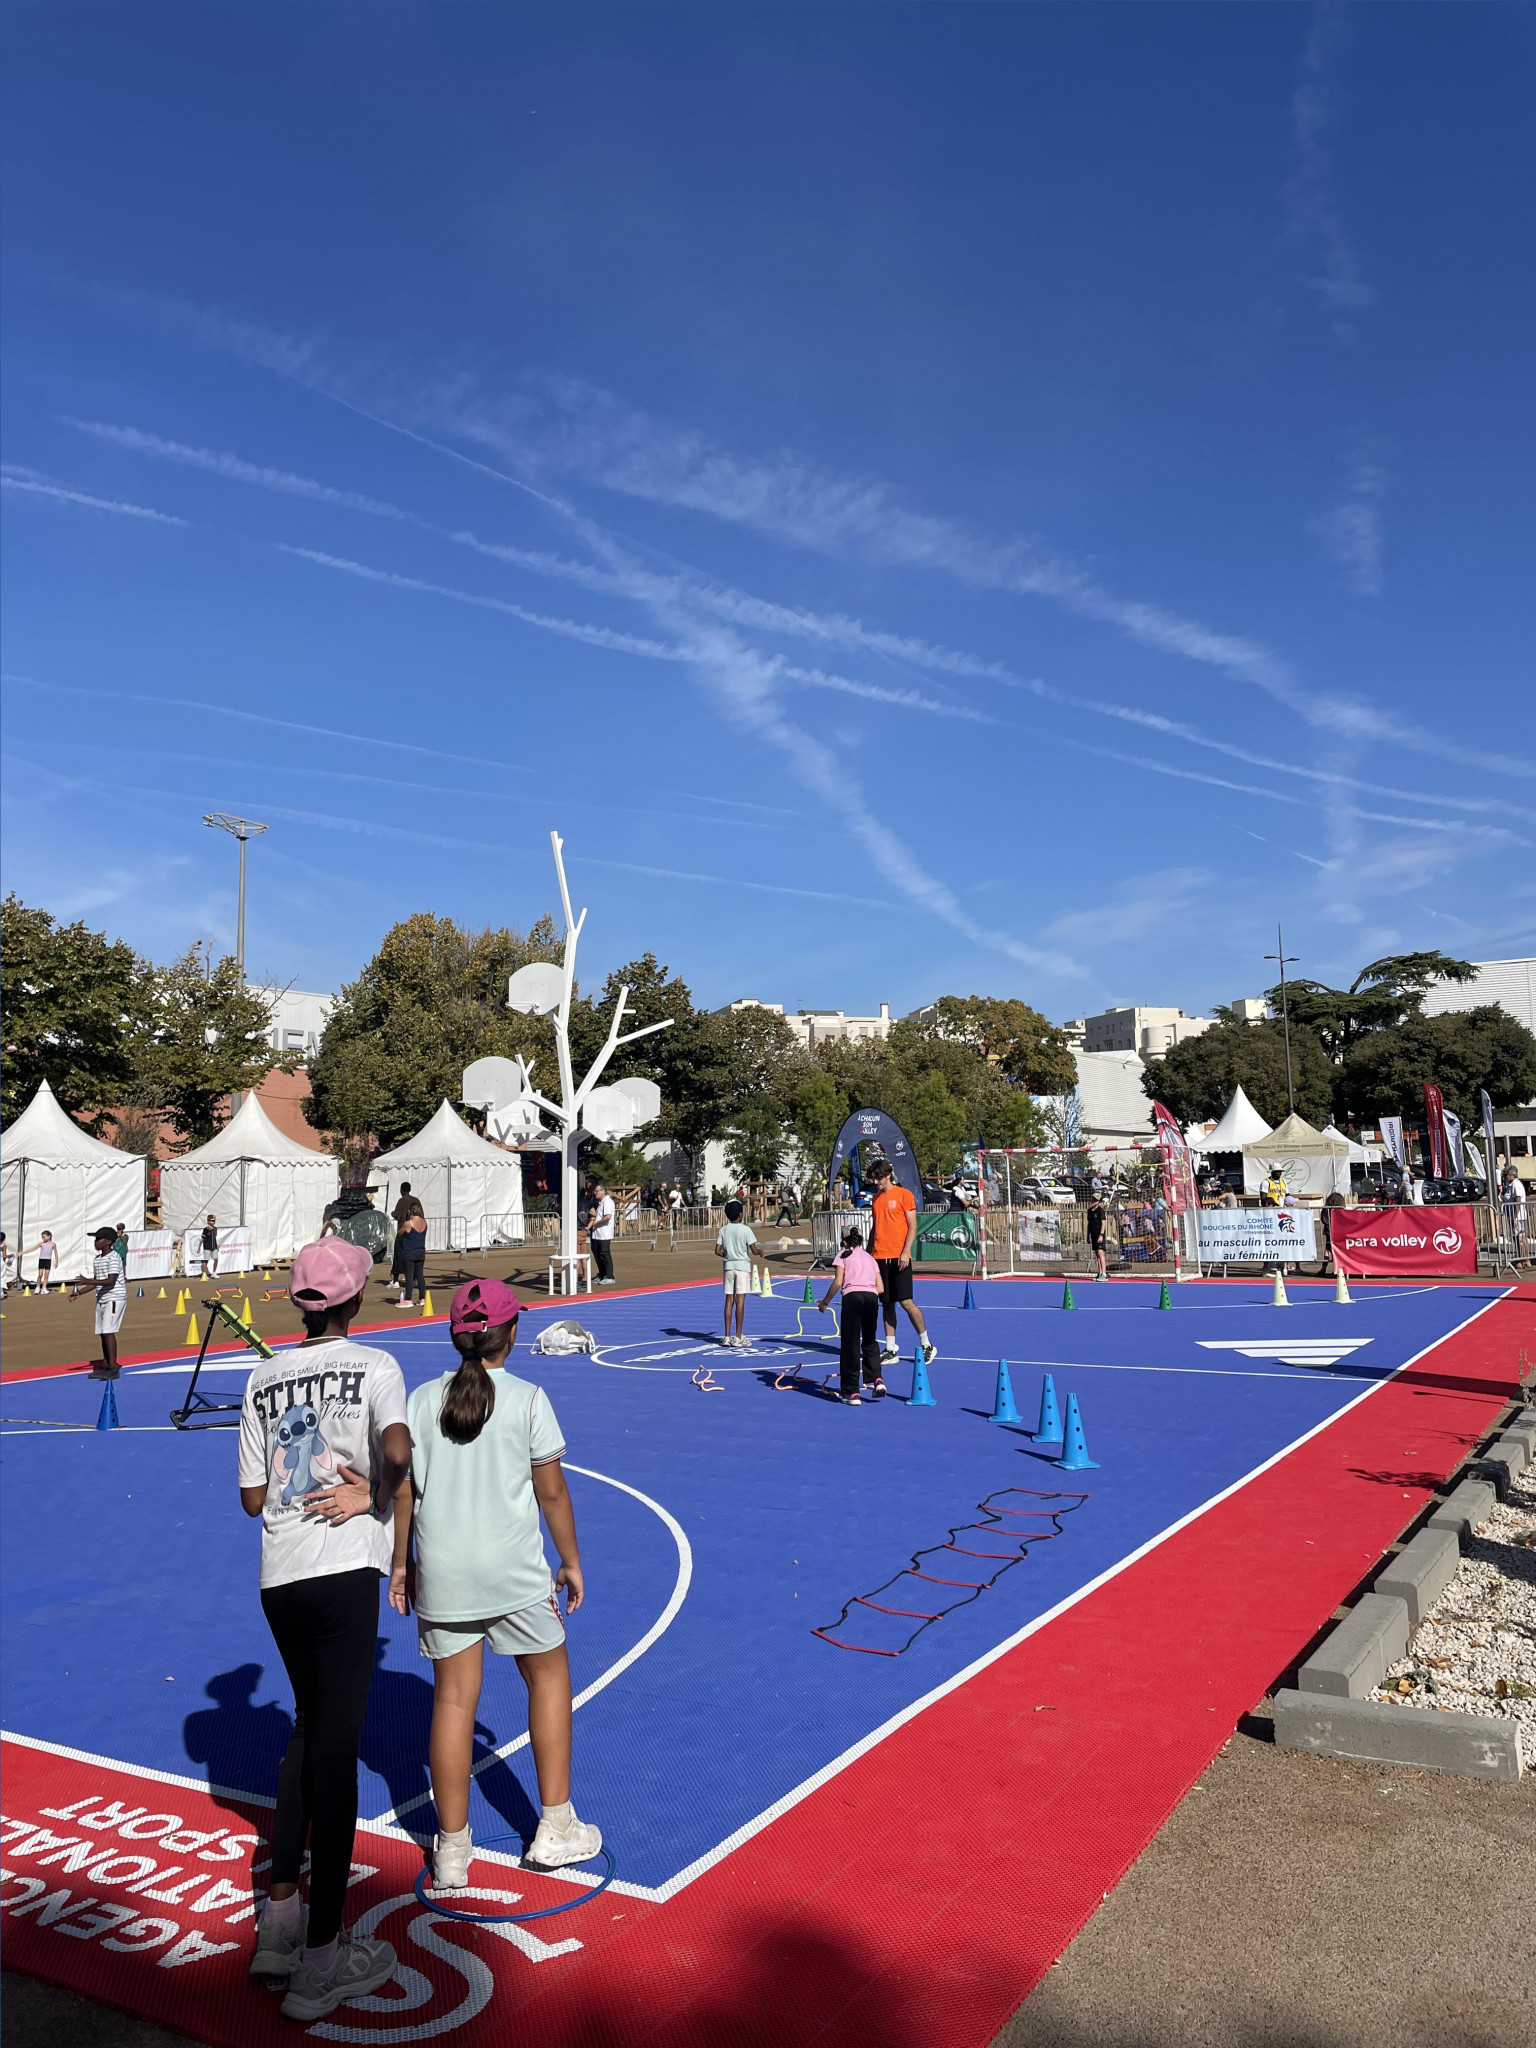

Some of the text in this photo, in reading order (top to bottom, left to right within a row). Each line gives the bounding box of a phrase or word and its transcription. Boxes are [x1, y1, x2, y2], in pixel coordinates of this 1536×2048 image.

[861, 1114, 881, 1122] CHACUN
[1248, 1222, 1274, 1230] RHÔNE
[919, 1230, 946, 1242] assis
[1213, 1237, 1261, 1247] masculin
[1264, 1239, 1306, 1247] comme
[1345, 1234, 1428, 1250] para volley
[1238, 1251, 1280, 1260] féminin
[251, 1381, 260, 1392] BIG
[281, 1370, 296, 1379] BIG
[324, 1361, 338, 1370] BIG
[339, 1361, 370, 1370] HEART
[252, 1370, 366, 1420] STITCH
[320, 1399, 361, 1421] Vibes
[38, 1796, 268, 1862] SPORT
[1, 1869, 241, 1969] AGENC
